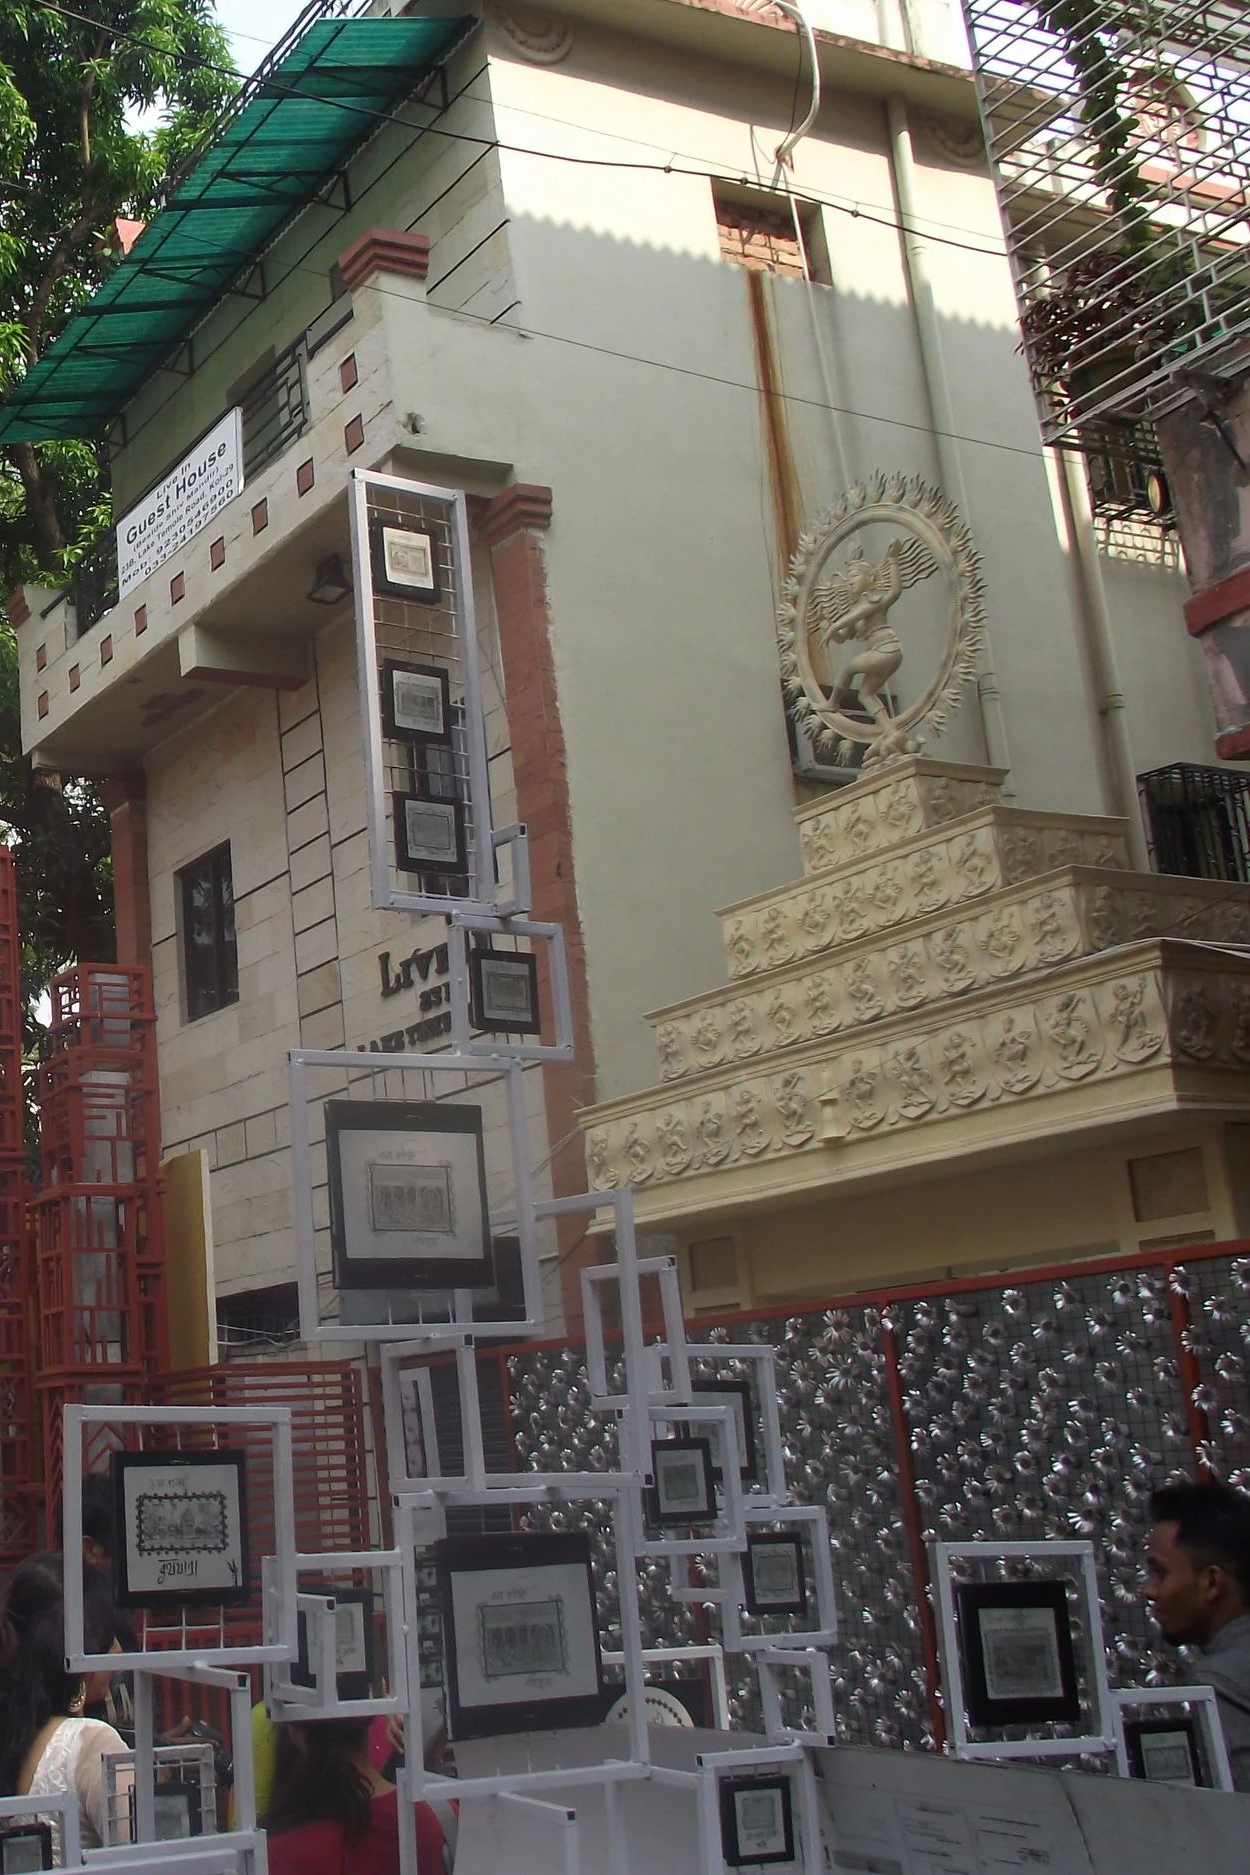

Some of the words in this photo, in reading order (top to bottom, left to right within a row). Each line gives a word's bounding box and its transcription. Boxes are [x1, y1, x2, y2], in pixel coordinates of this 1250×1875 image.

[127, 494, 170, 545] Guest
[176, 442, 226, 500] House
[157, 475, 177, 500] Live
[181, 461, 190, 475] In
